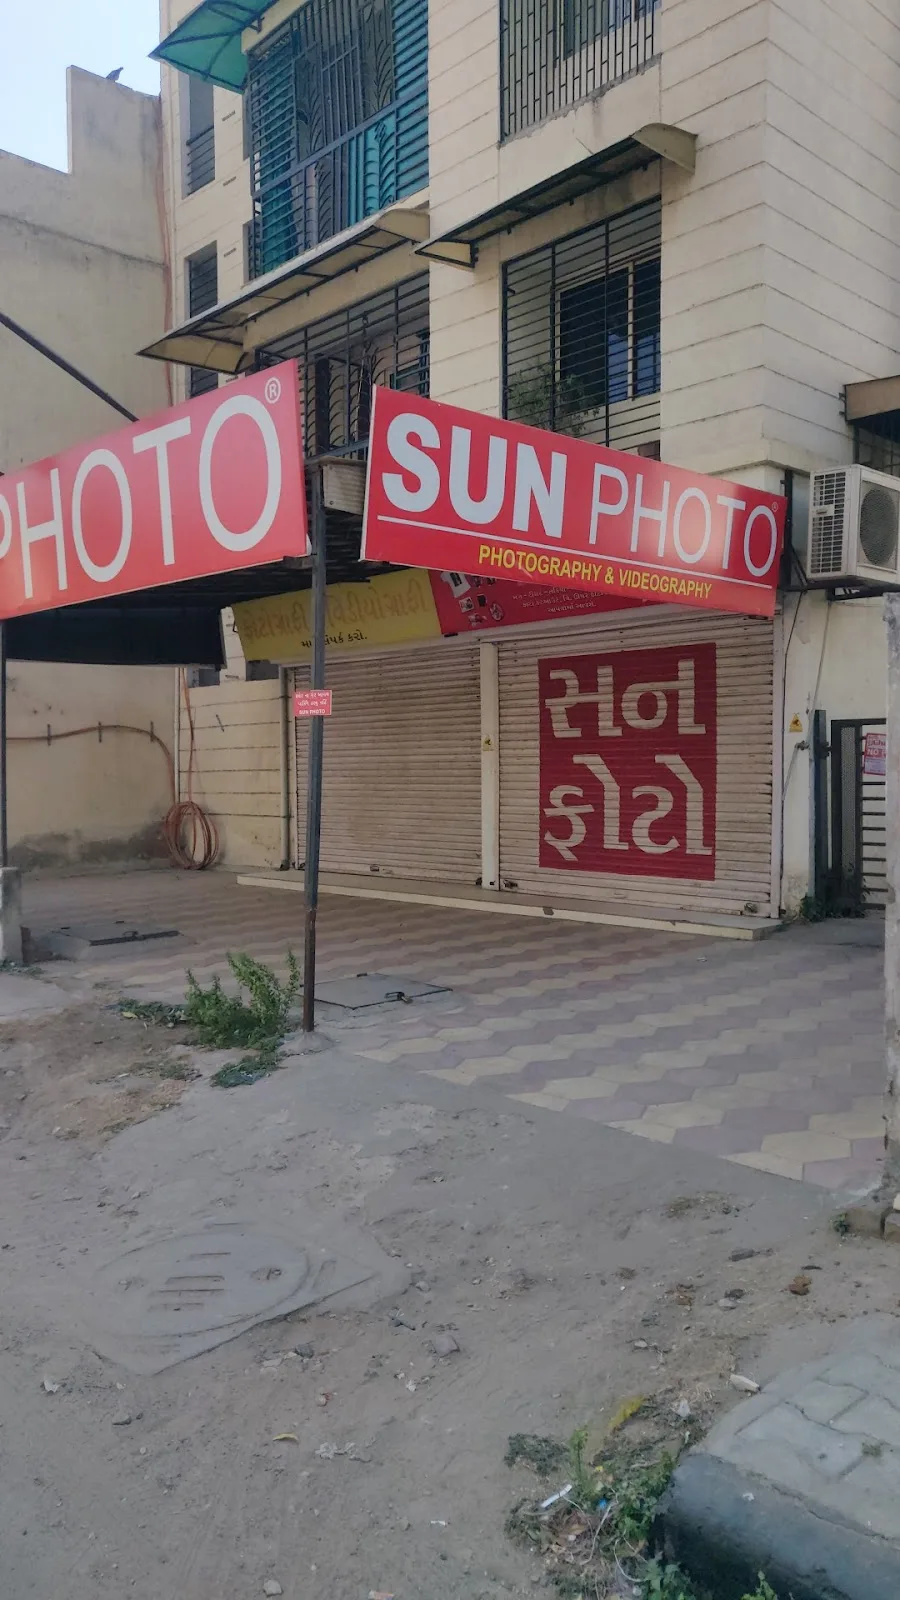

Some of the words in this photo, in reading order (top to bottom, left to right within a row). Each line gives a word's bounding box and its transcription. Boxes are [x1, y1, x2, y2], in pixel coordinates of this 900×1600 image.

[382, 412, 567, 540] SUN
[478, 544, 603, 588] PHOTOGRAPHY
[604, 567, 615, 586] &
[618, 568, 713, 600] VIDEOGRAPHY
[545, 658, 707, 738] સન
[543, 753, 713, 862] ફોટો
